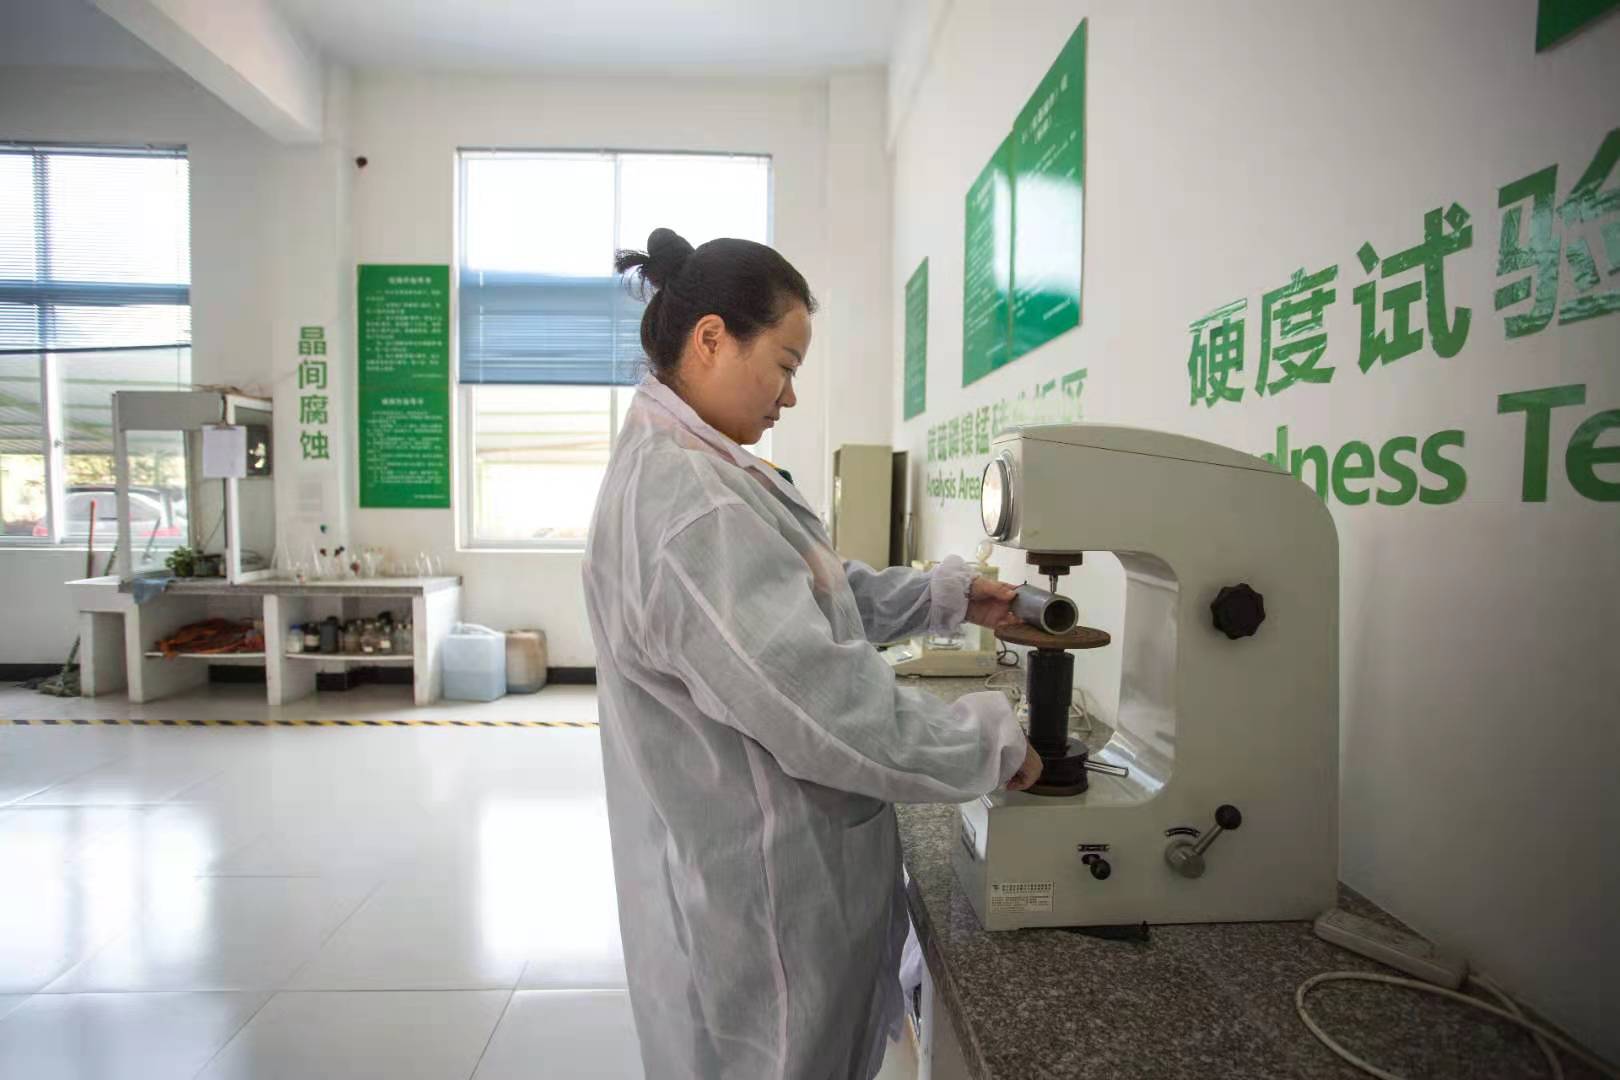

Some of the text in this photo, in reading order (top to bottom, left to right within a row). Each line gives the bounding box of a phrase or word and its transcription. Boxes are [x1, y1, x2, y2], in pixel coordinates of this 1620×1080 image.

[1187, 127, 1620, 408] 硬度试验
[298, 326, 330, 460] 晶间腐蚀
[927, 468, 981, 507] Analysis Area
